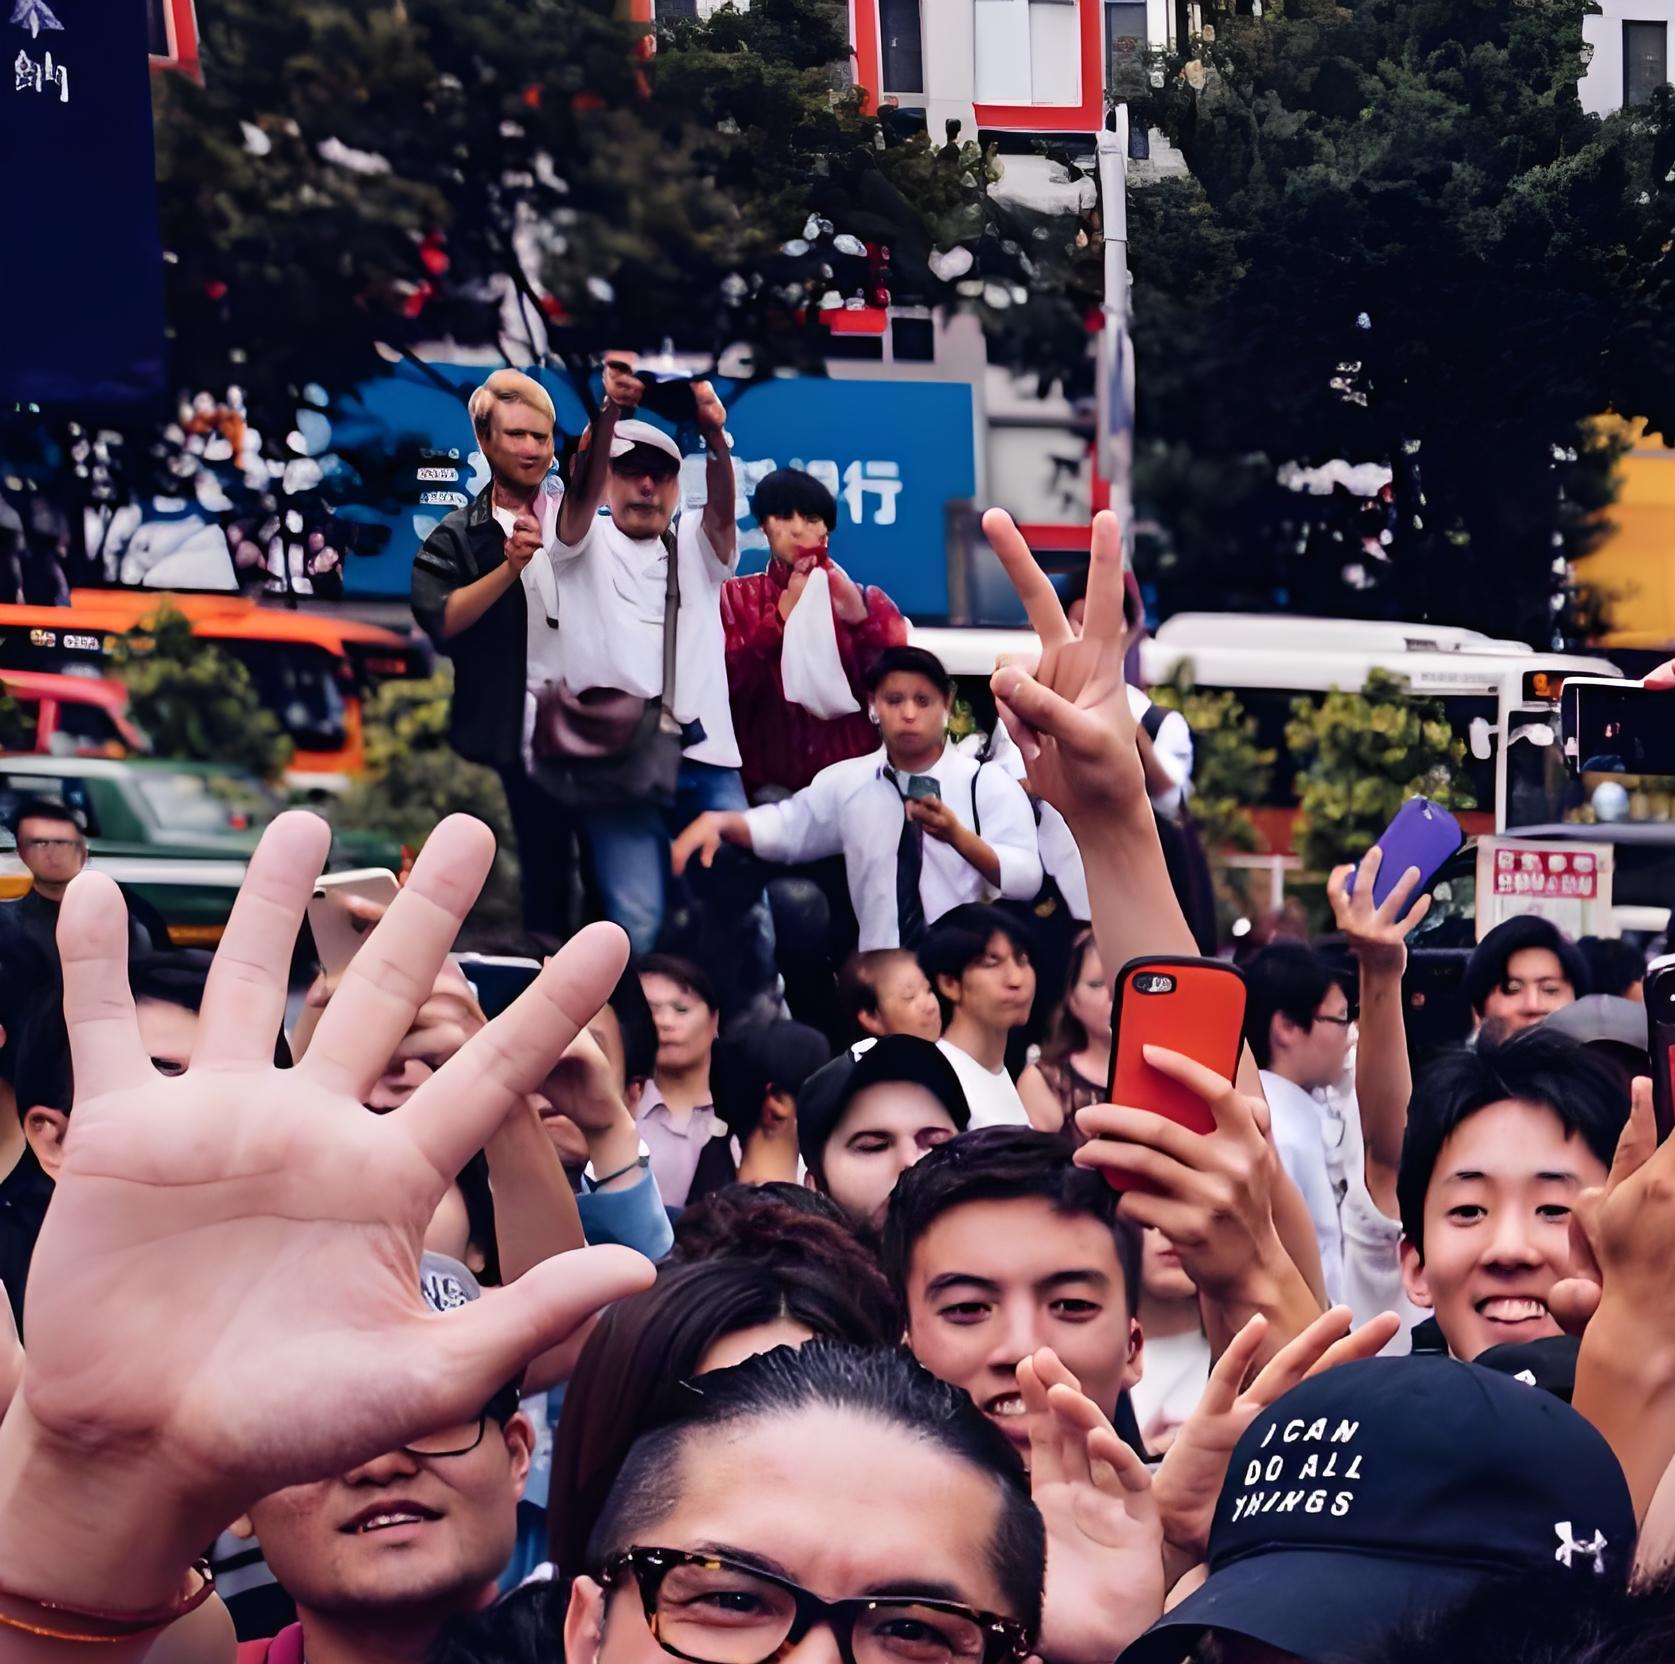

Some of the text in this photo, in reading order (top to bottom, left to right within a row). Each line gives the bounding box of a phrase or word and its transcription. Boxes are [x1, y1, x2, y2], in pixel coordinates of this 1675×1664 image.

[1260, 1417, 1360, 1448] I CAN
[1244, 1451, 1362, 1486] DO ALL
[1232, 1489, 1354, 1523] THINGS
